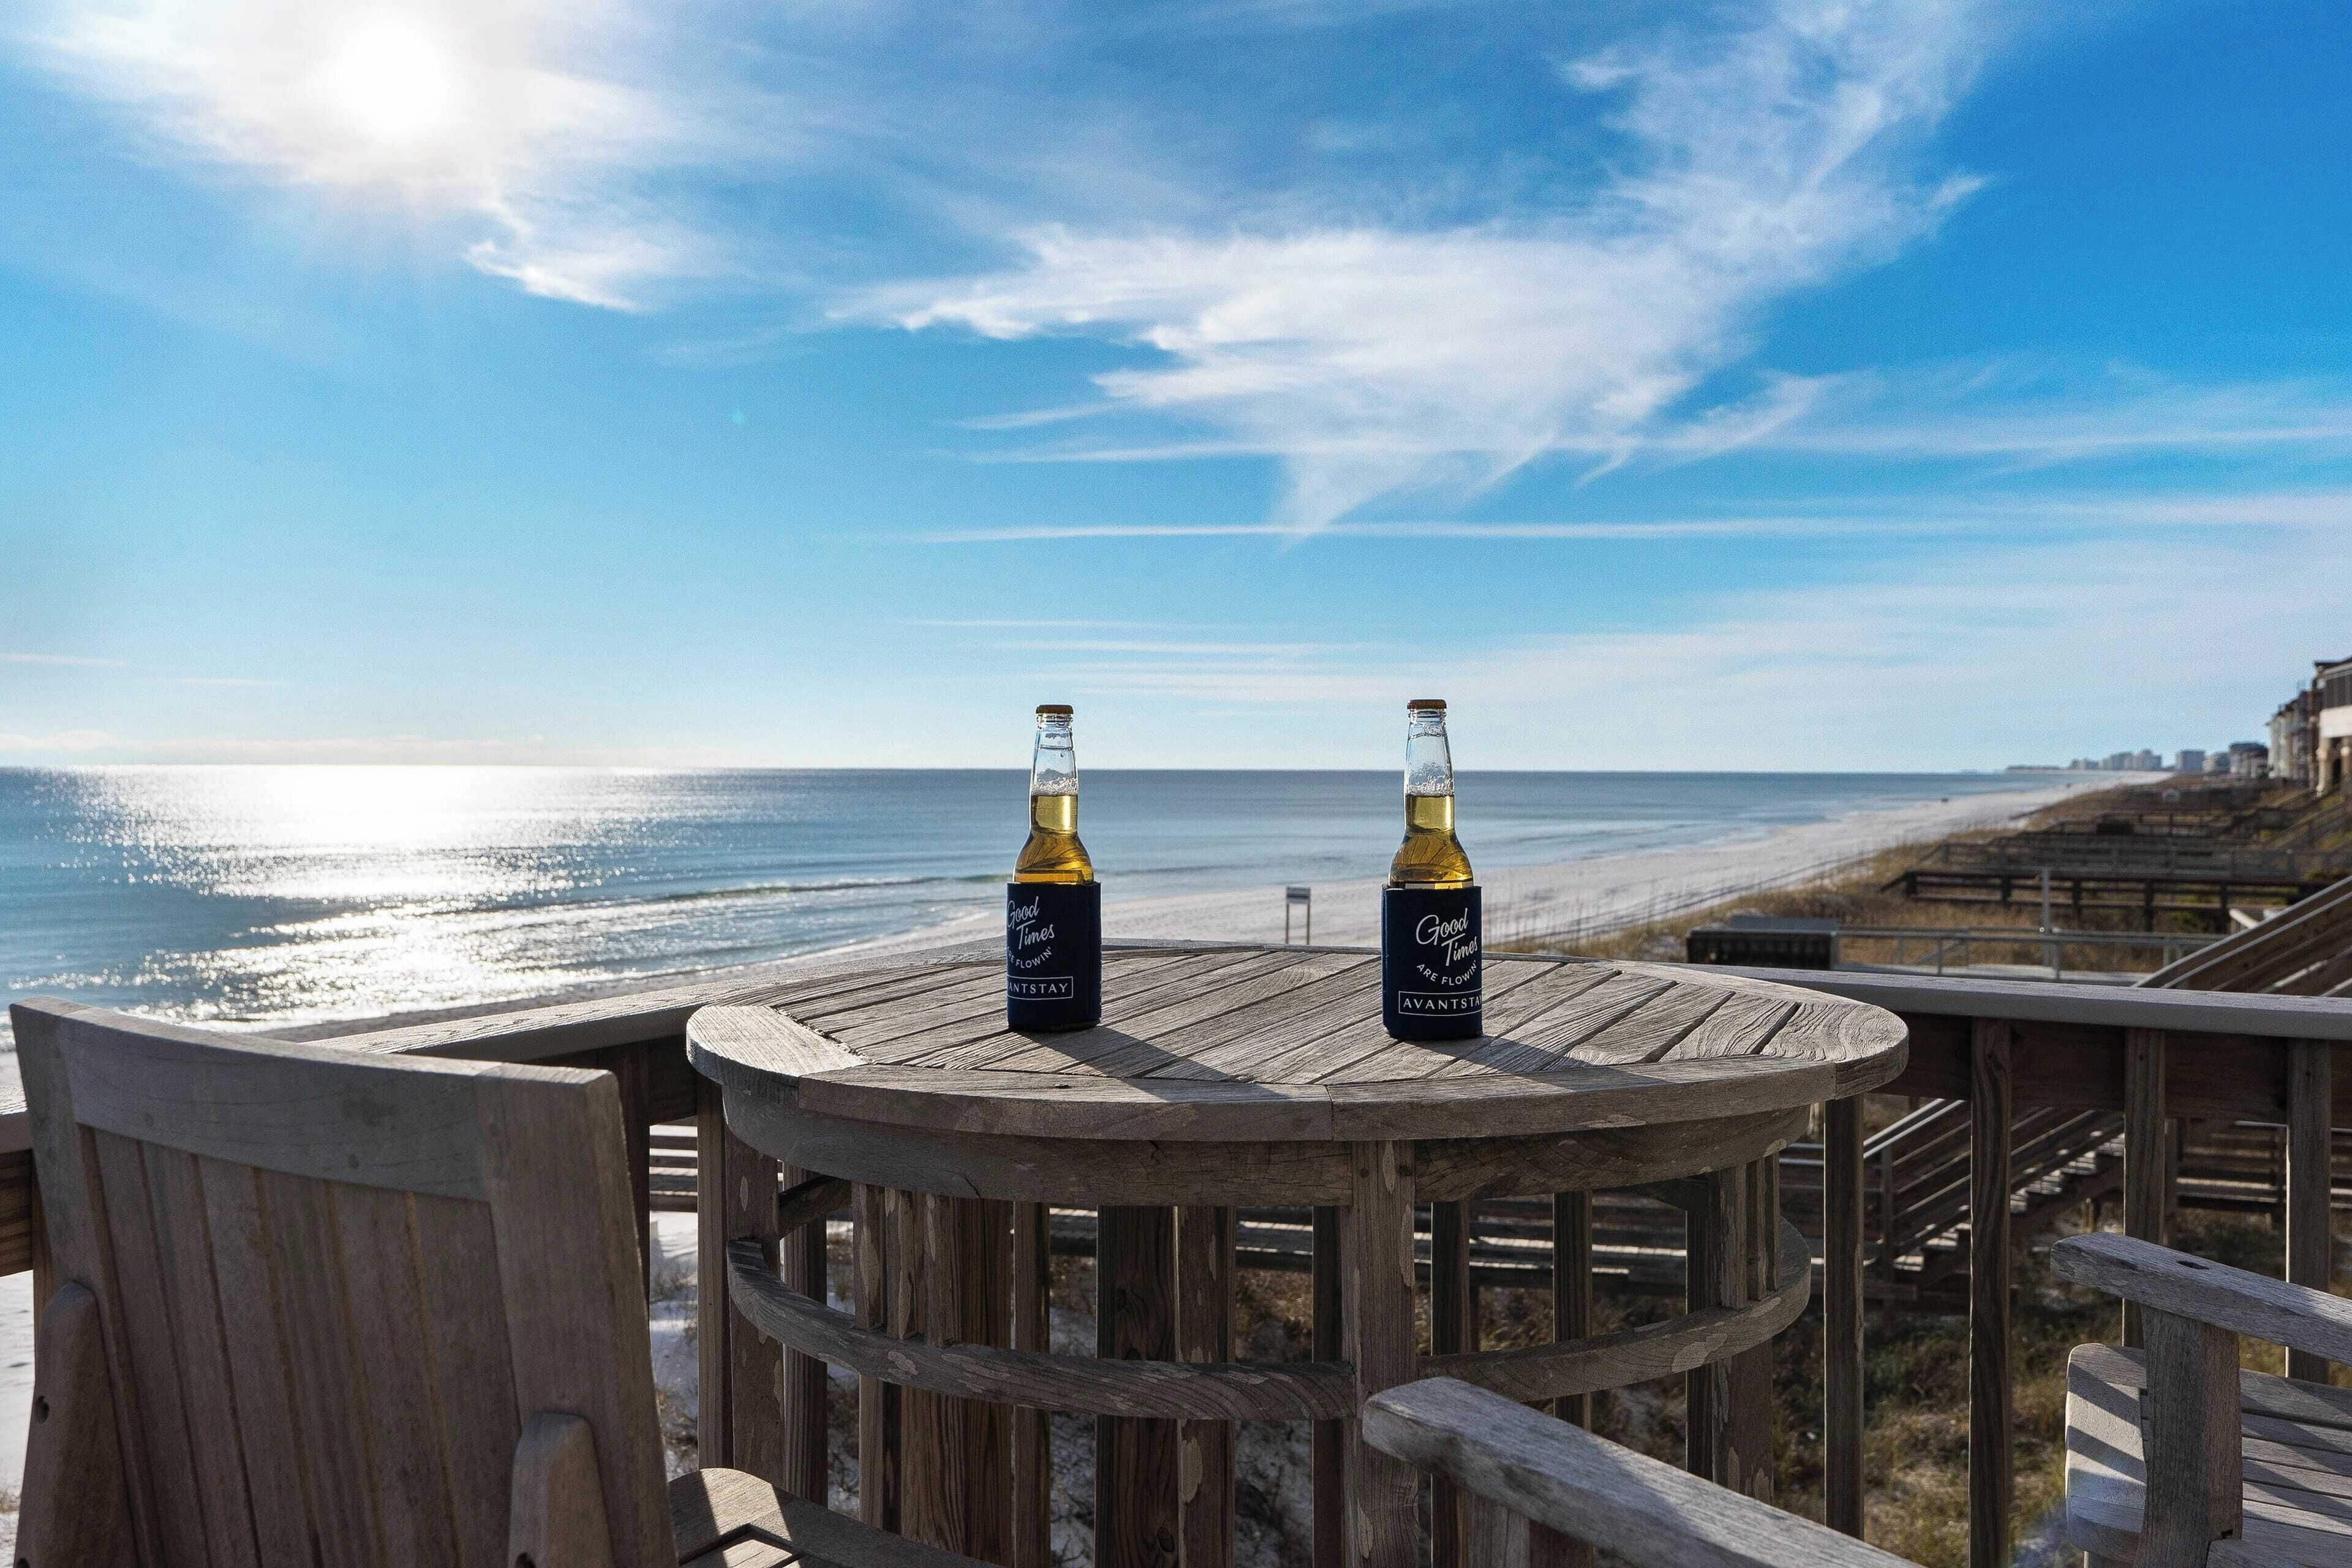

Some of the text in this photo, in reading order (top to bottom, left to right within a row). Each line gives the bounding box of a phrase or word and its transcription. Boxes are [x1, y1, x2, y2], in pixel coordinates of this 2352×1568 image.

[1006, 896, 1039, 929] Good
[1415, 908, 1469, 946] Good
[1016, 919, 1055, 949] Times
[1016, 946, 1053, 968] FLOWIN'
[1441, 933, 1478, 967] Times
[1007, 982, 1068, 994] ANTSTAY
[1416, 960, 1477, 986] ARE FLOWIN'
